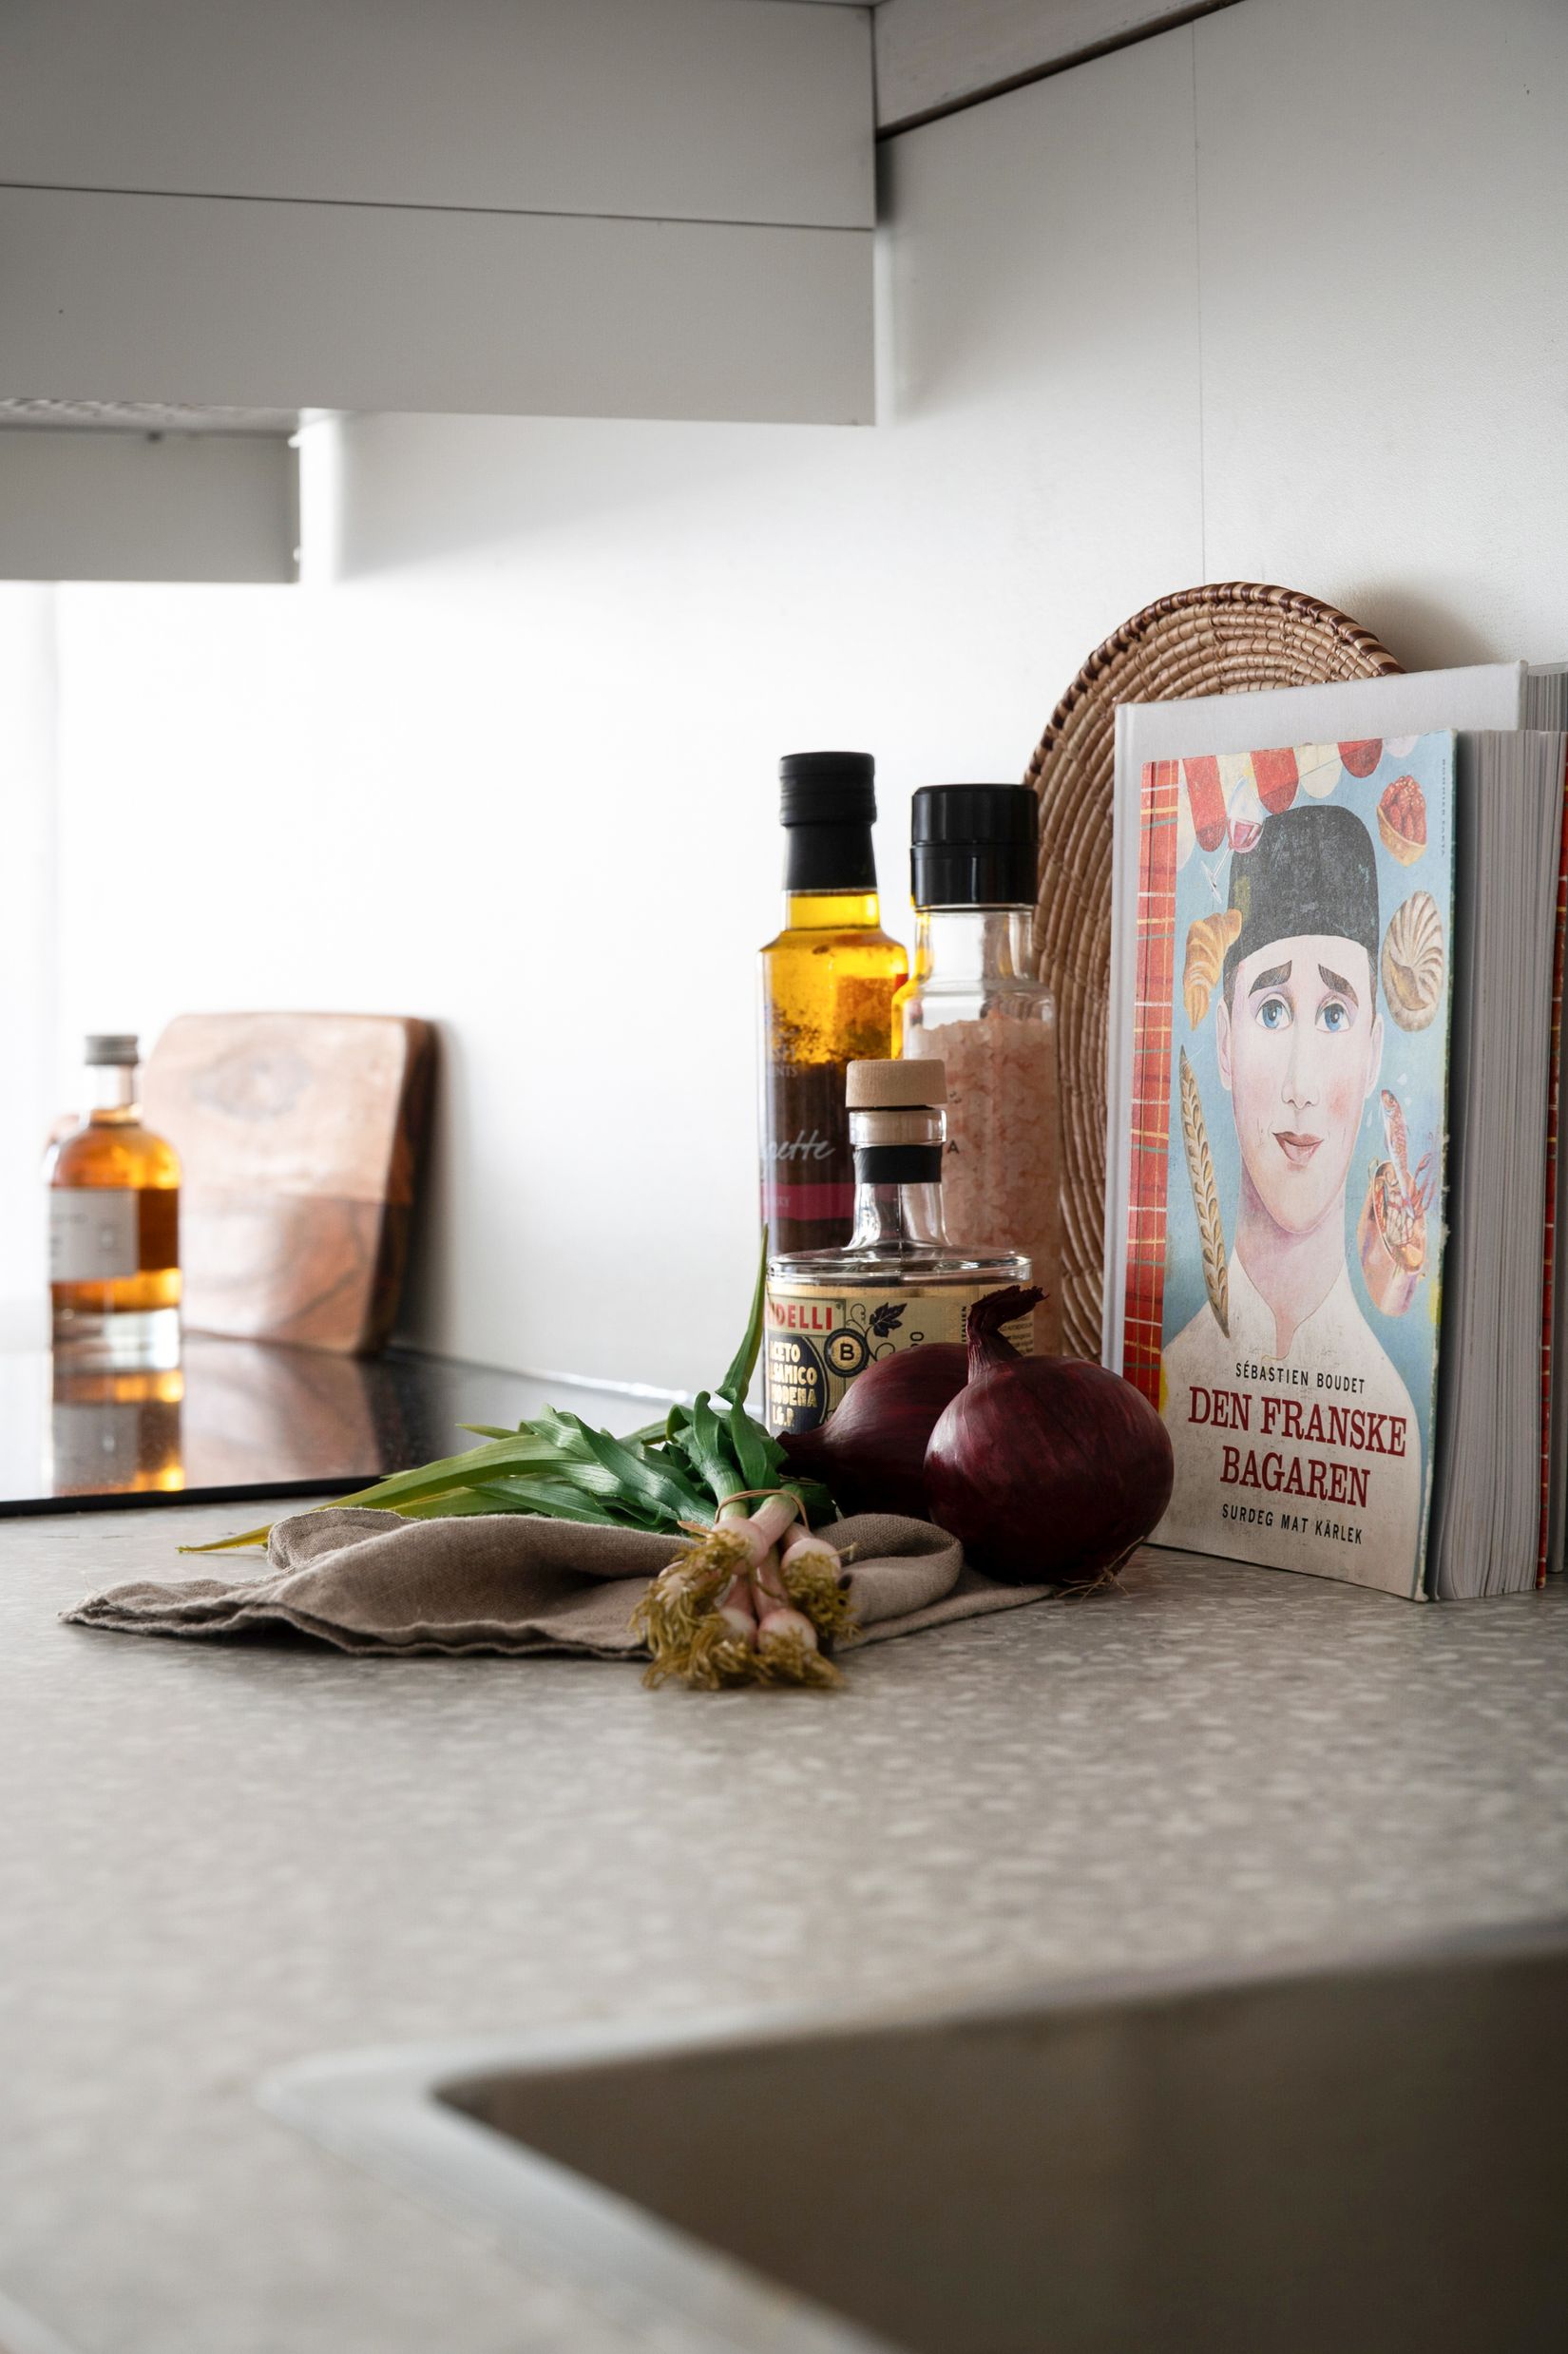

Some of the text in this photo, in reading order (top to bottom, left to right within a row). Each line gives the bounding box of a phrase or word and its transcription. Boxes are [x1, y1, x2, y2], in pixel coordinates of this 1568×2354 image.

[840, 1343, 855, 1361] B
[1235, 1360, 1365, 1394] SÉBASTIEN BOUDET
[1188, 1386, 1406, 1457] DEN FRANSKE
[1219, 1445, 1371, 1508] BAGAREN
[1222, 1503, 1363, 1545] SURDEG MAT KÄRLEK
